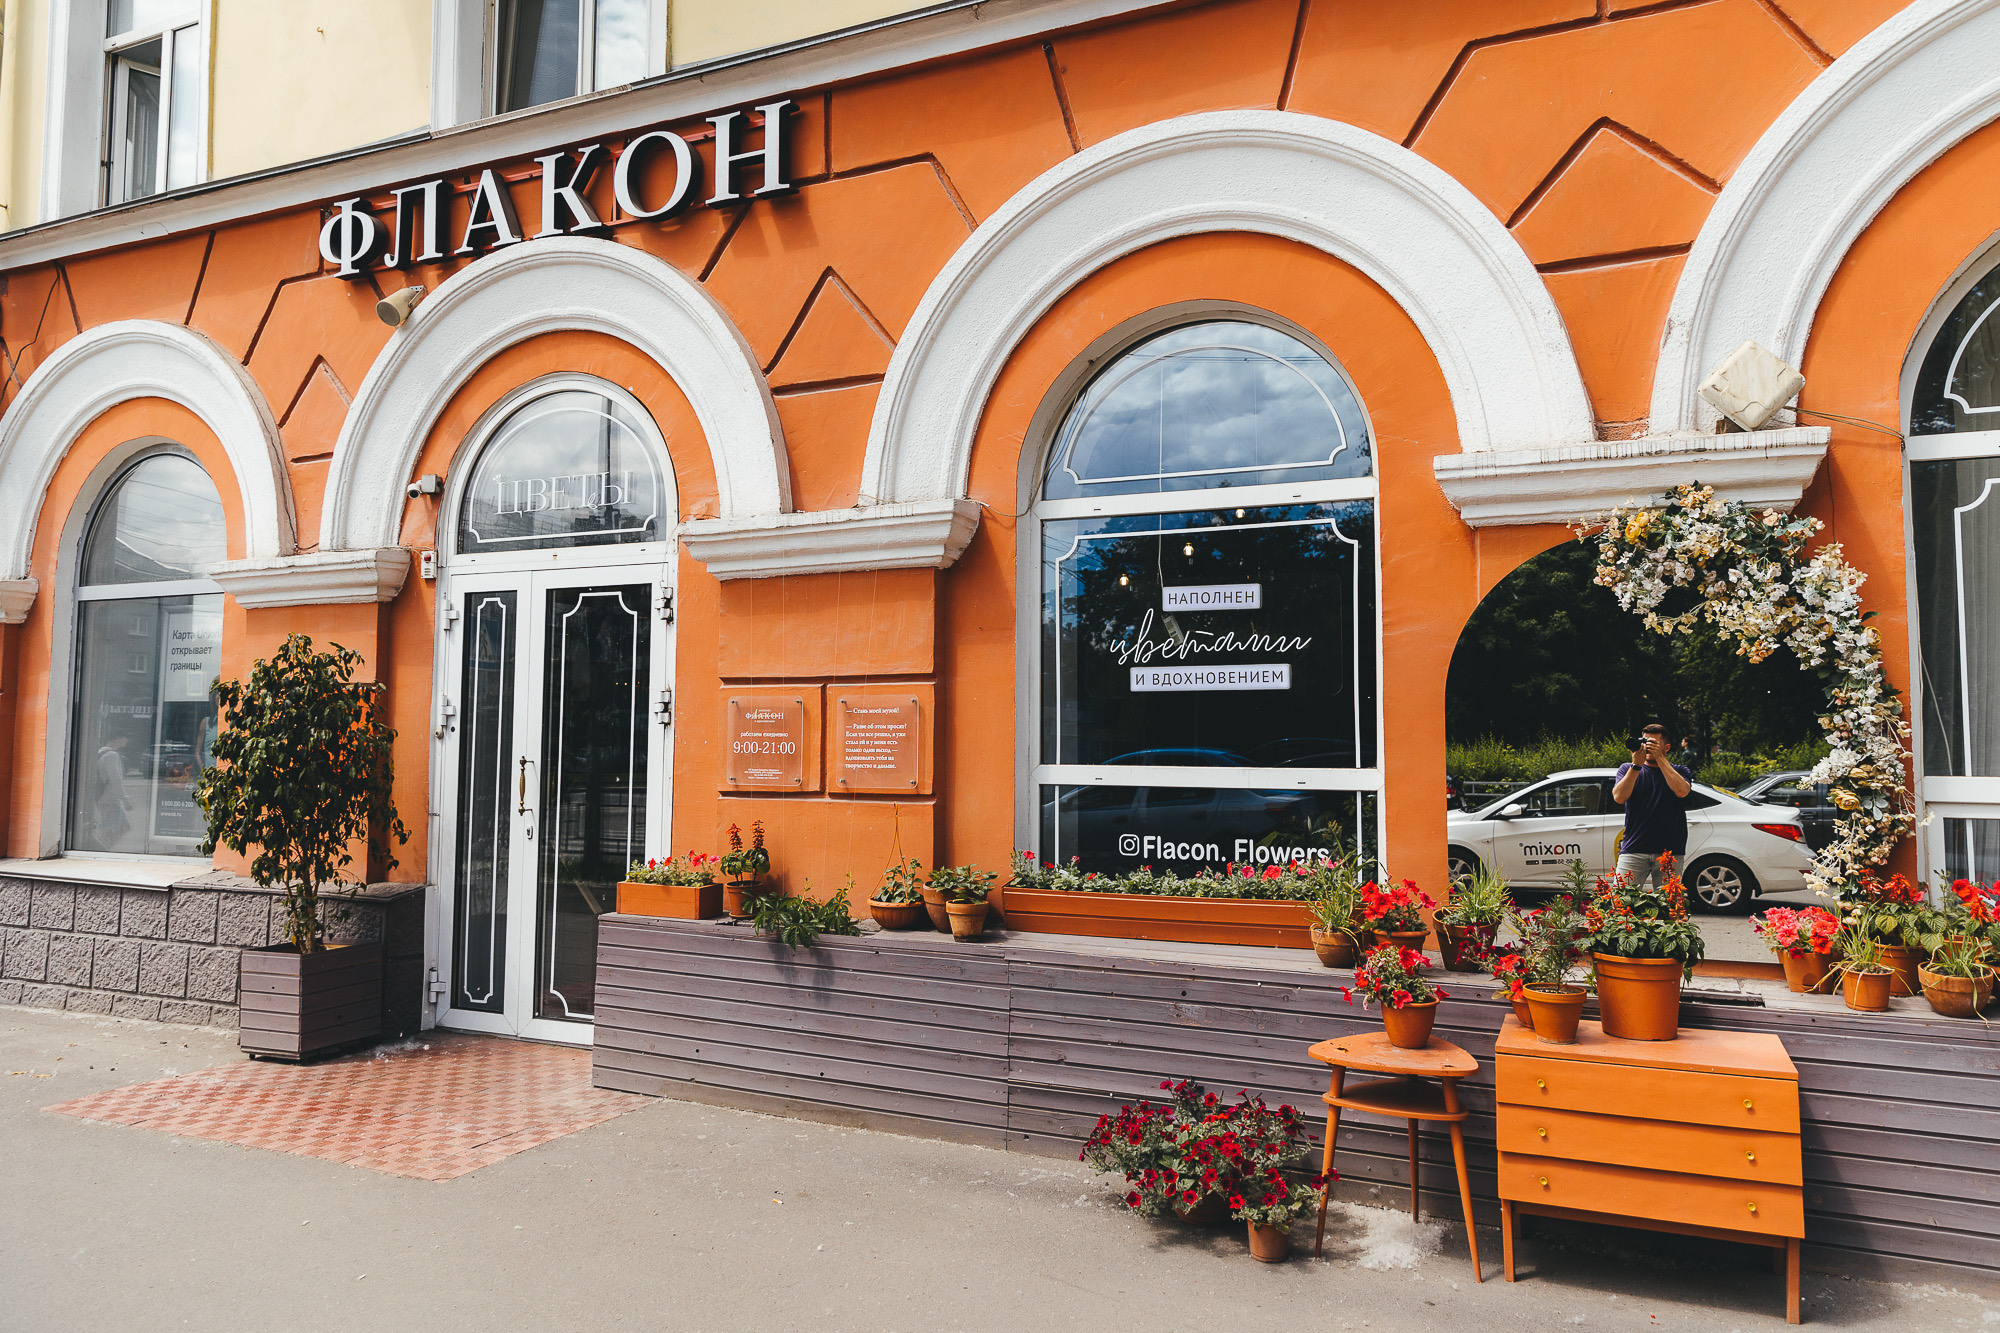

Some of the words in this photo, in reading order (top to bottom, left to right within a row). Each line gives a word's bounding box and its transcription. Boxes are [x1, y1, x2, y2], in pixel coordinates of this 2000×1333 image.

[318, 99, 797, 280] ФЛАКОН
[493, 468, 634, 518] ЦВЕТЫ
[1168, 590, 1255, 606] НАПОЛНЕН
[172, 629, 195, 641] Карта
[1110, 608, 1312, 665] цветами
[171, 646, 213, 657] открывает
[170, 662, 202, 672] границы
[1135, 673, 1145, 686] И
[1152, 670, 1285, 688] ВДОХНОВЕНИЕМ
[733, 741, 796, 755] 9:00-21:00
[1234, 838, 1331, 866] Flowers
